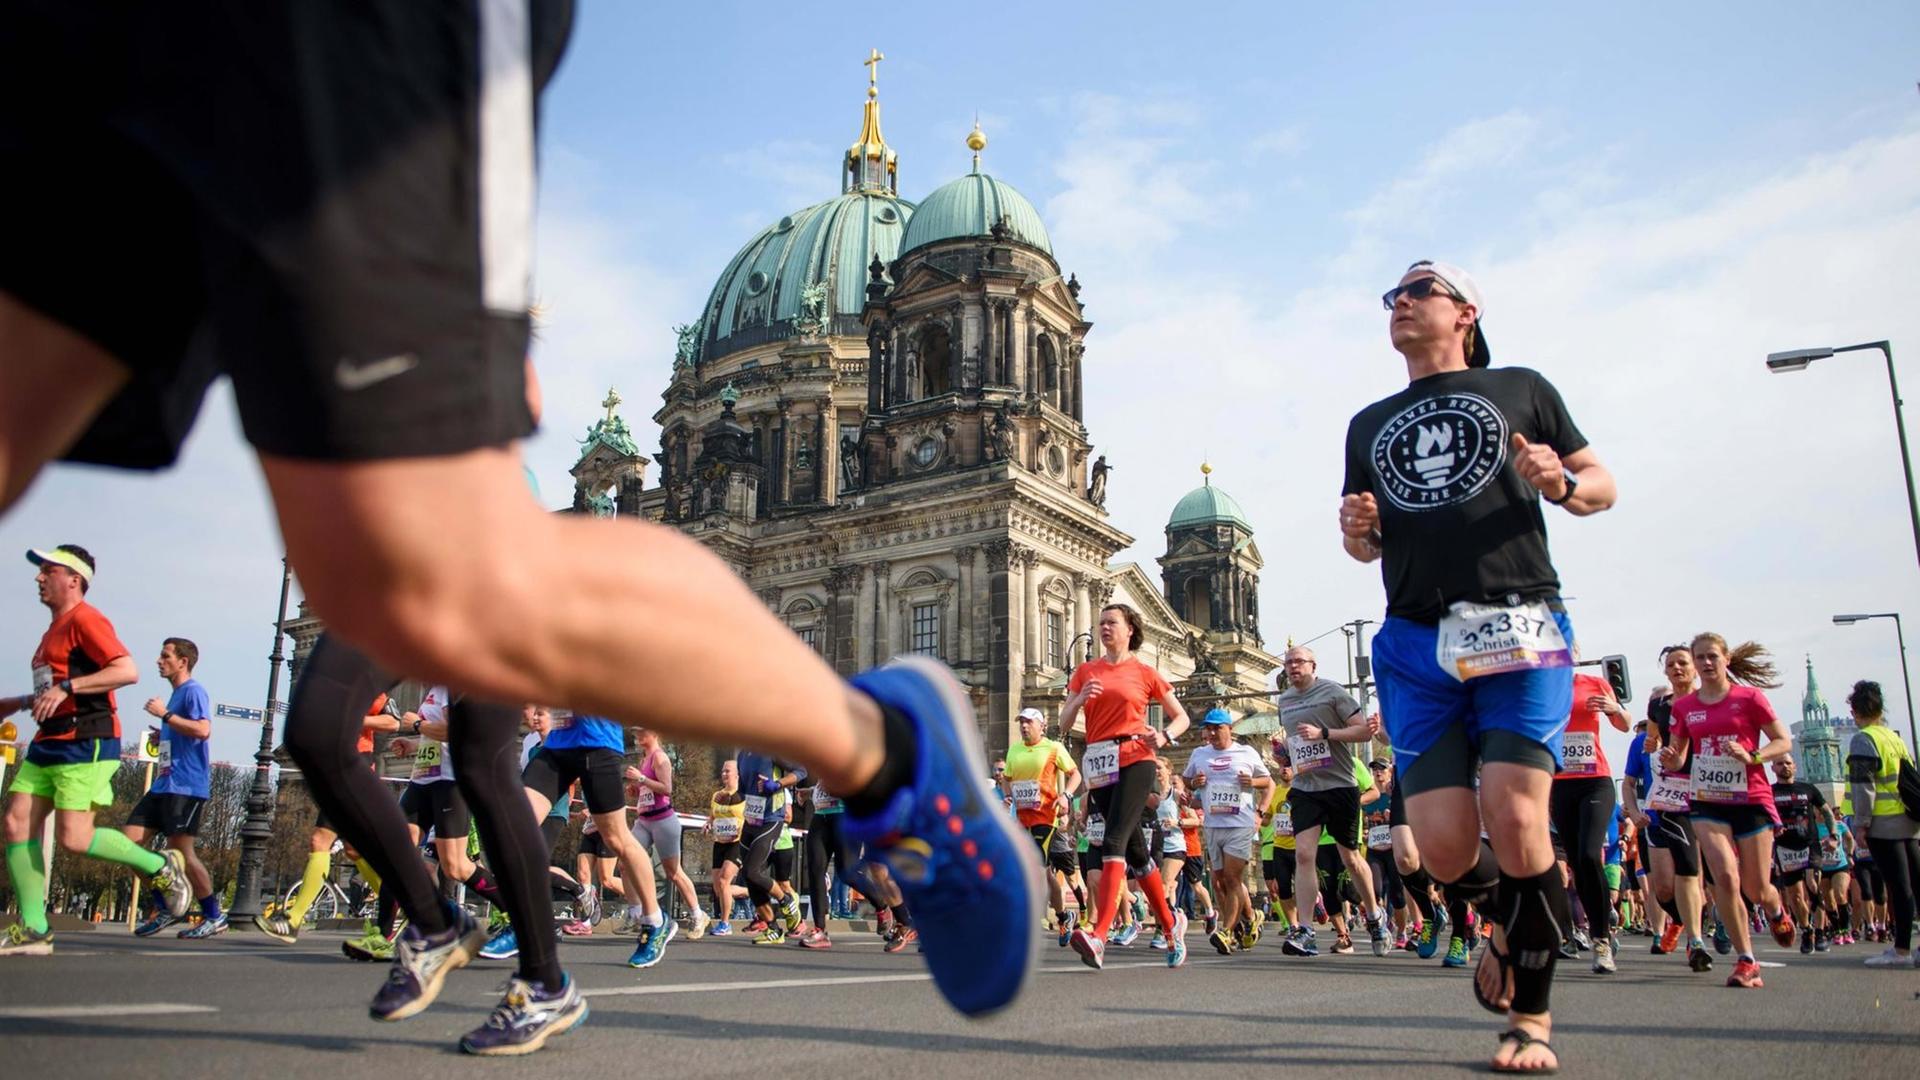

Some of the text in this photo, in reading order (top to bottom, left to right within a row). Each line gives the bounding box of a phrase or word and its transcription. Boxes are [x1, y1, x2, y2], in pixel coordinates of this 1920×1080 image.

[1376, 399, 1498, 471] WILLPOWER RUNNING
[1420, 488, 1450, 502] THE
[1460, 457, 1491, 489] LINE
[1296, 743, 1326, 759] 25958
[1698, 770, 1742, 784] 34601
[1211, 792, 1239, 802] 31313
